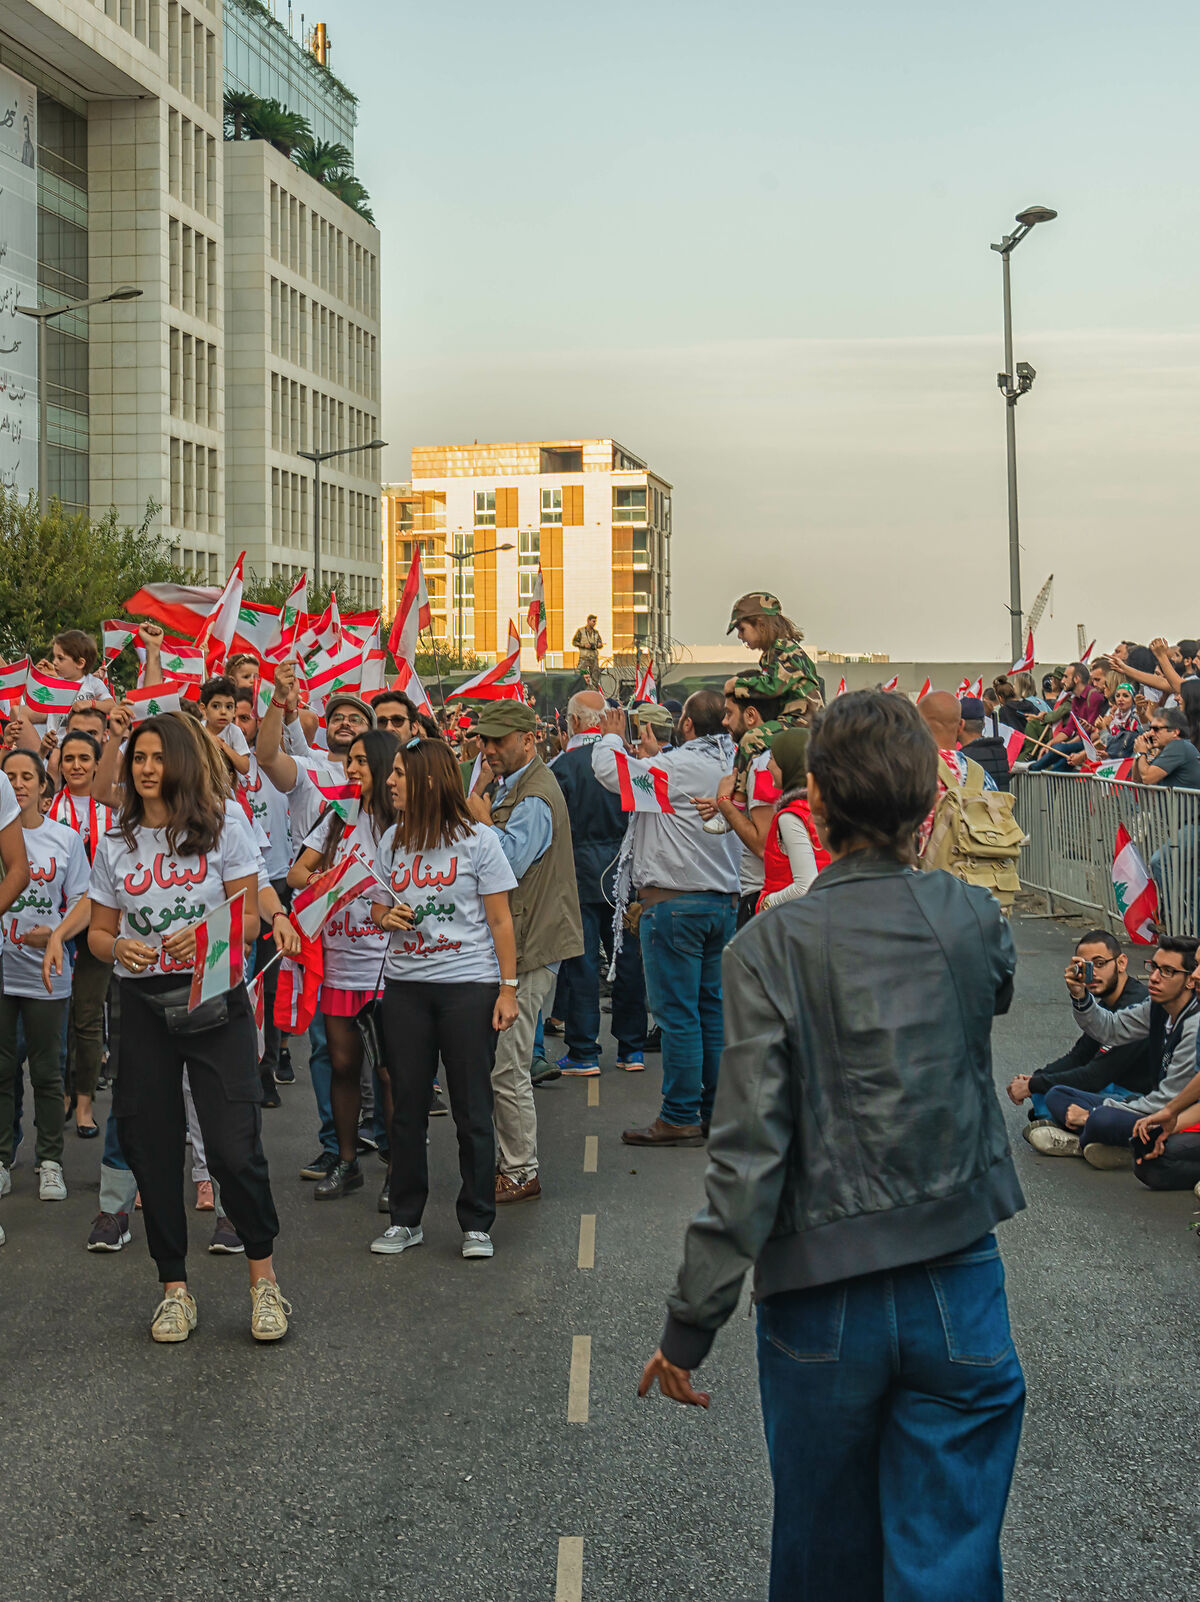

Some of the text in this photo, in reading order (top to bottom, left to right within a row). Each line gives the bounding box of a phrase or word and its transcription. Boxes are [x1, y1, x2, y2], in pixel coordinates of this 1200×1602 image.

[123, 852, 208, 896] لبنان
[391, 854, 458, 893] لبنان
[7, 888, 53, 916] بيقو
[393, 931, 463, 958] بشبابو
